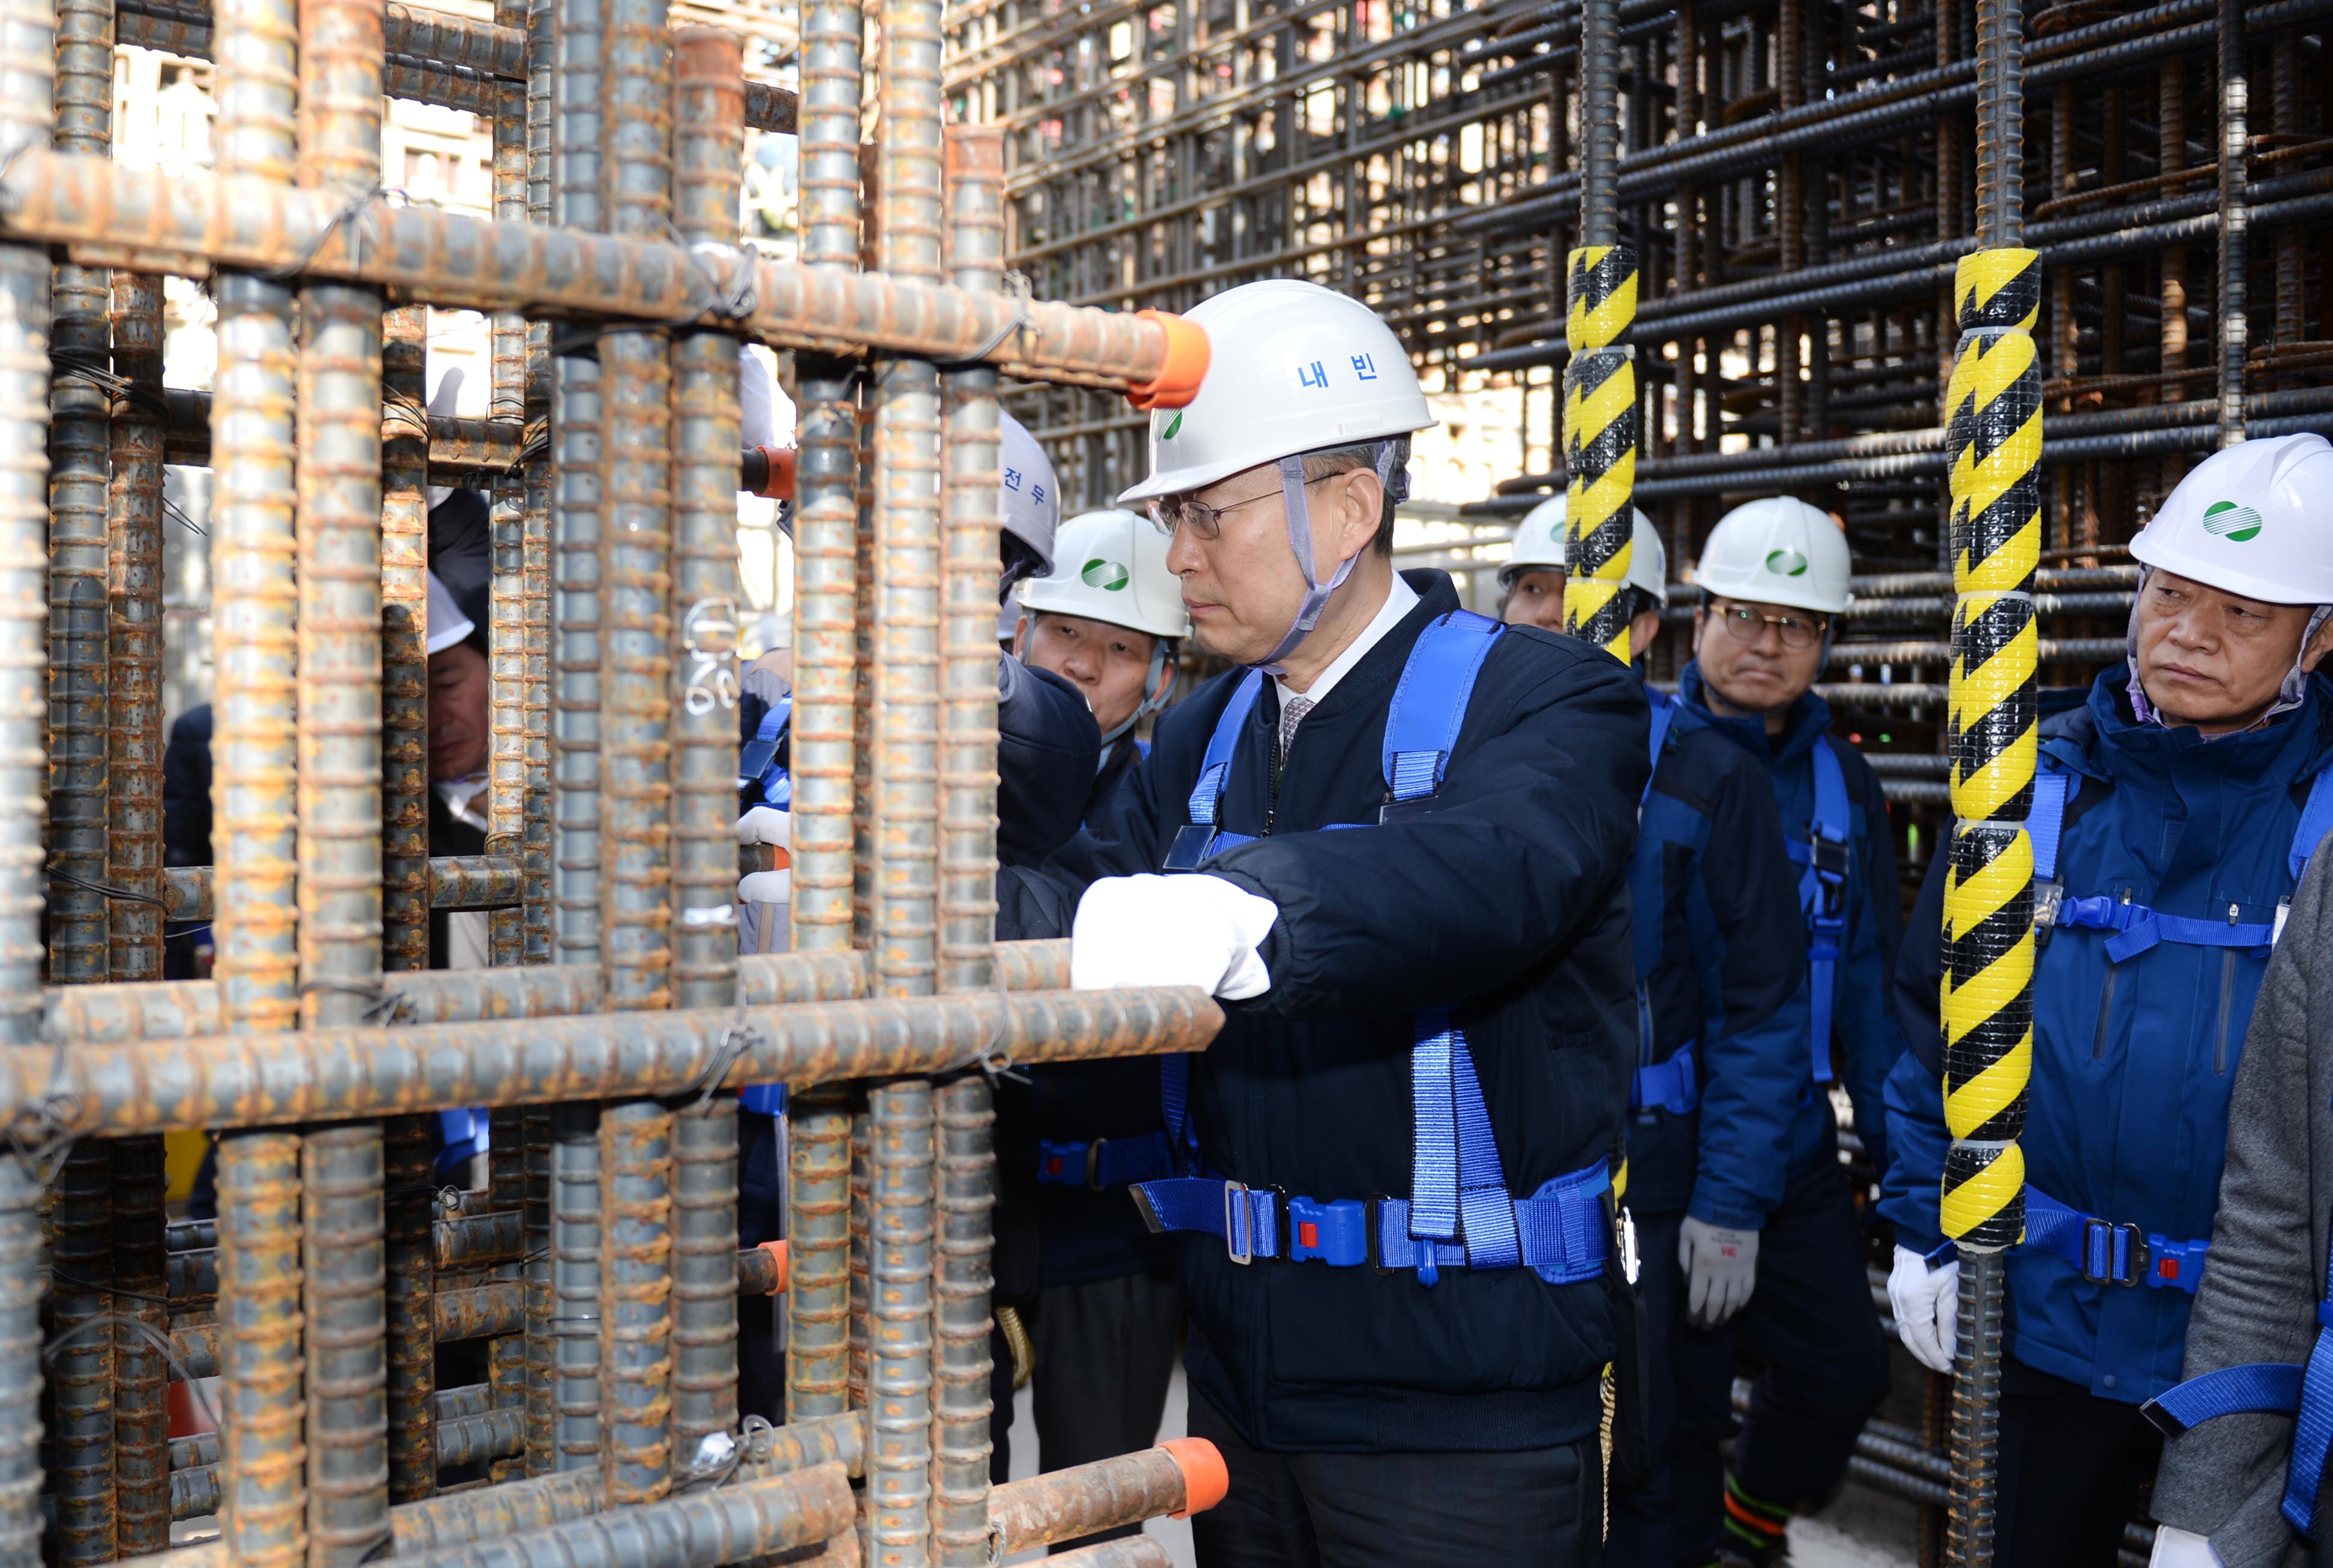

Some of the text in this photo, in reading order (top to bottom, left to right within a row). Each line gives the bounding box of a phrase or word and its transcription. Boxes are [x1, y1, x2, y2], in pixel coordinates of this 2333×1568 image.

[1297, 353, 1377, 388] 내 빈
[1004, 467, 1045, 505] 전 무
